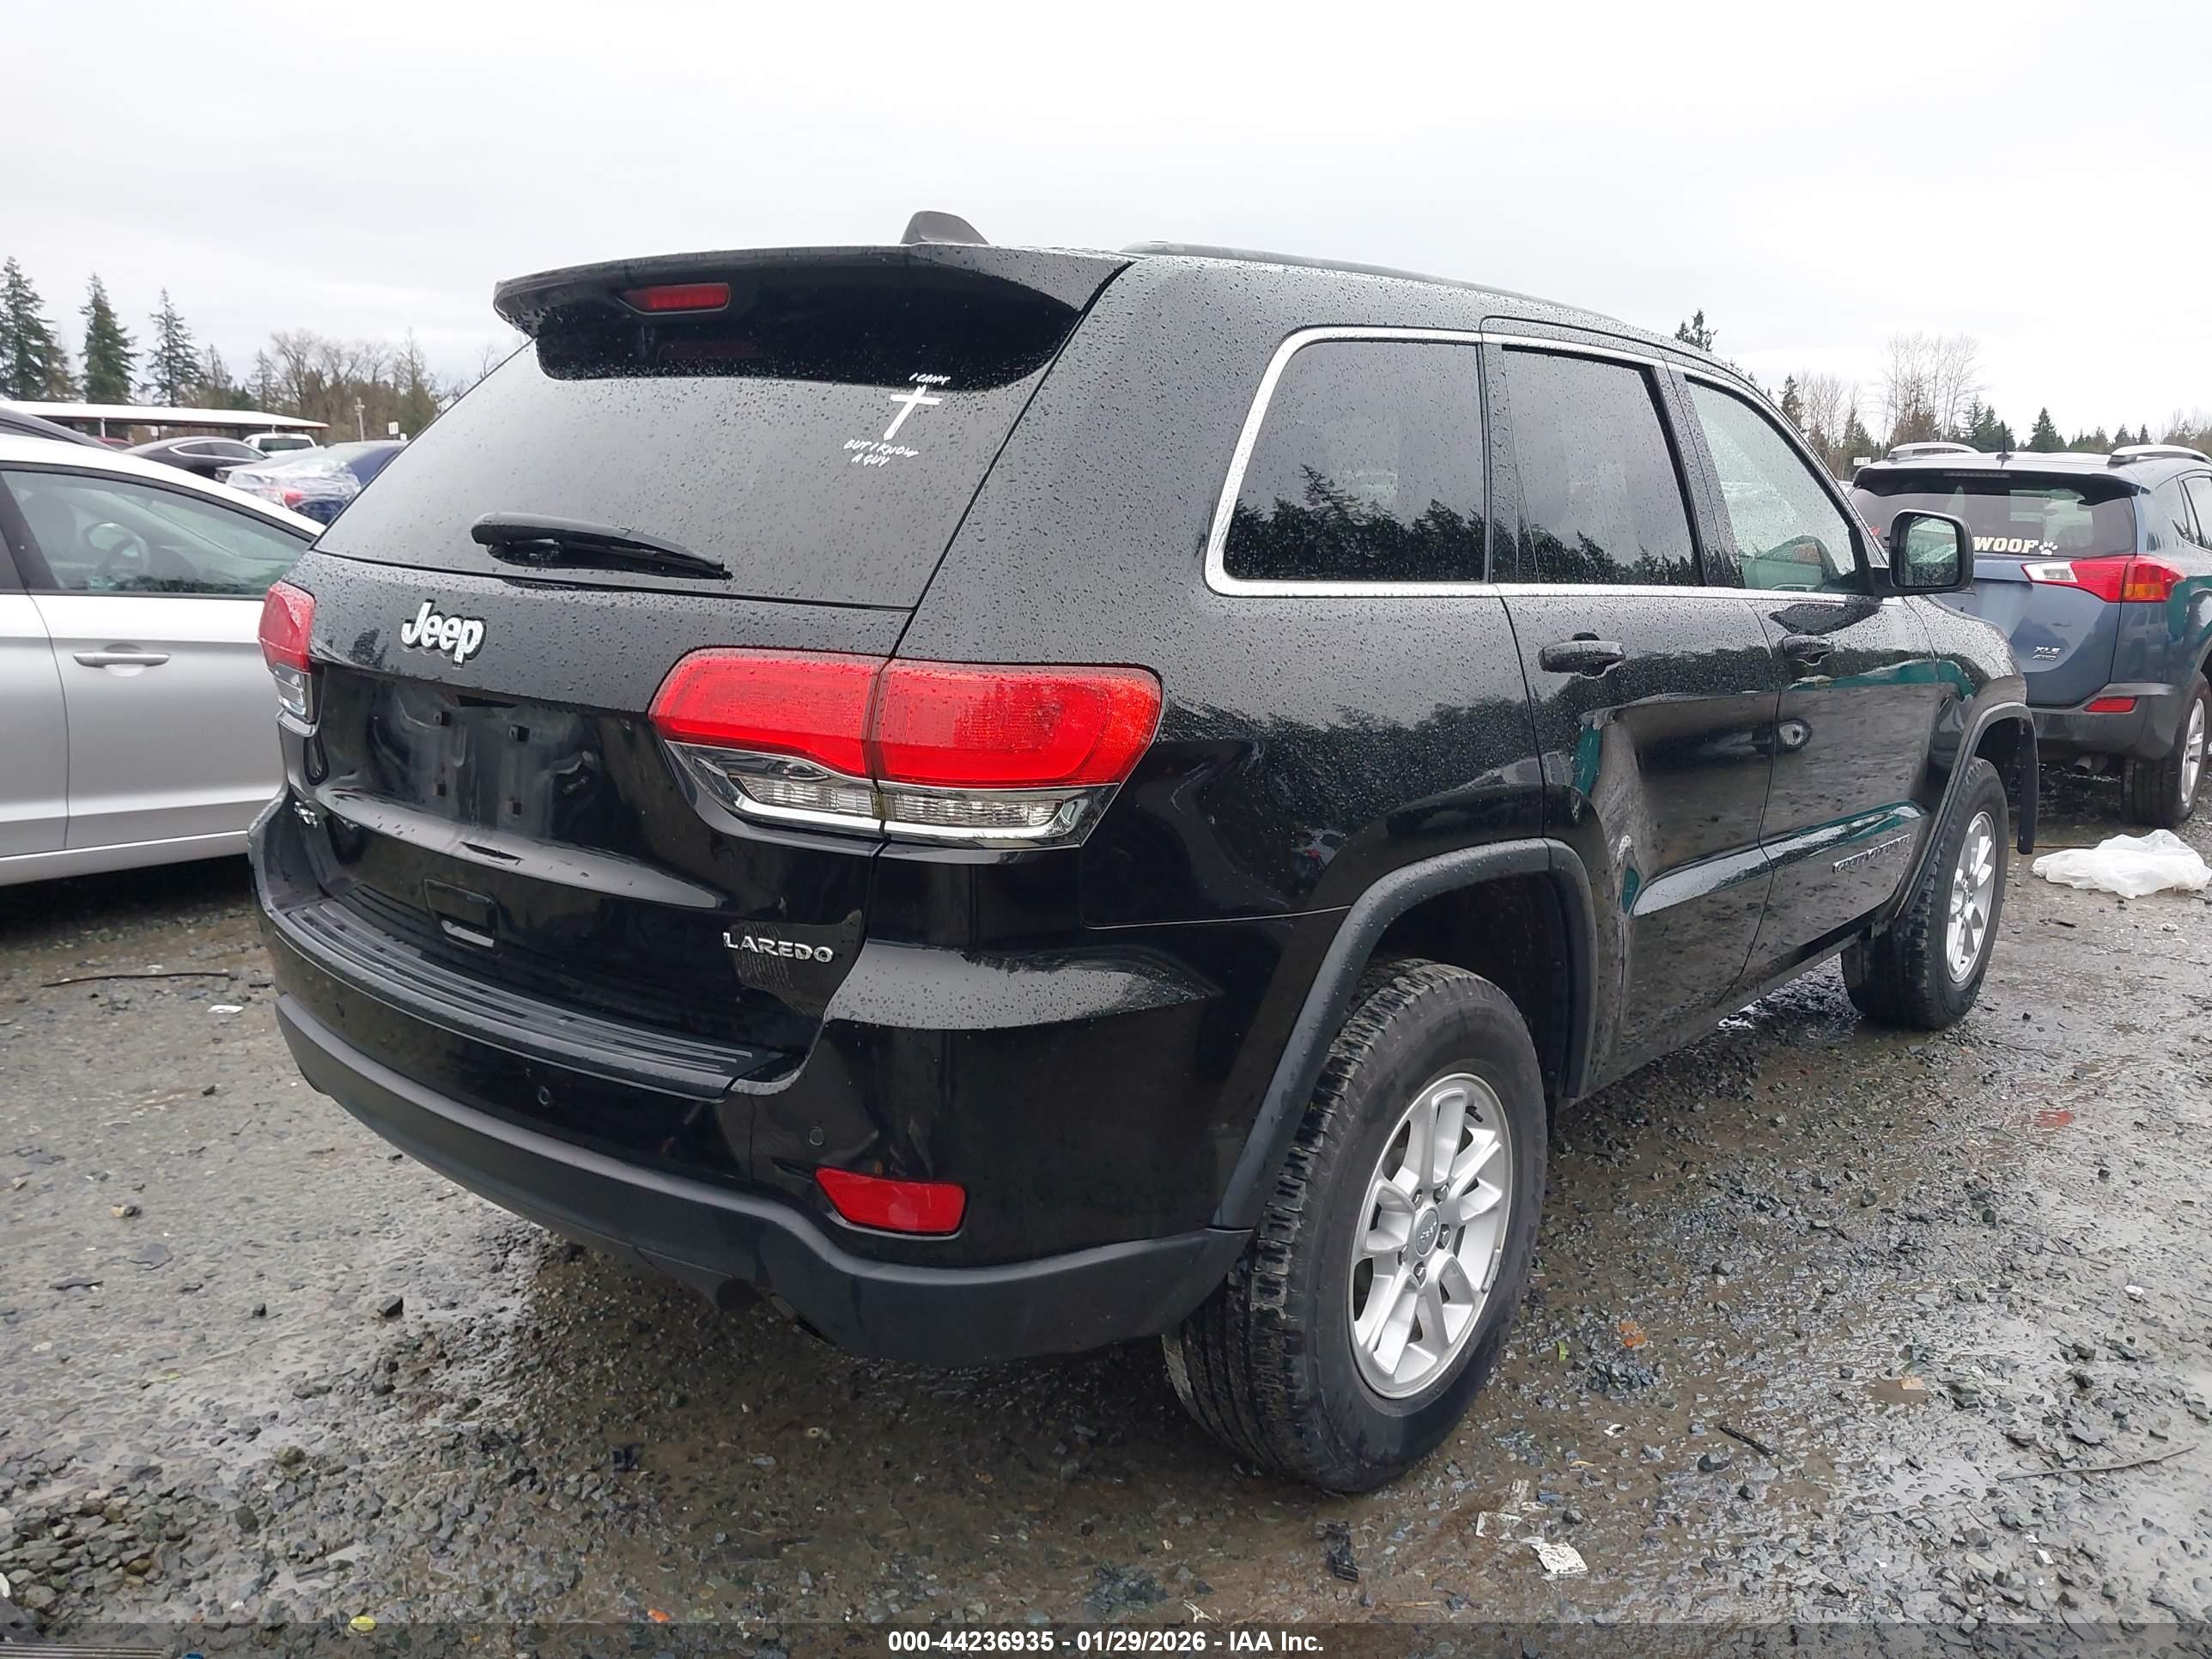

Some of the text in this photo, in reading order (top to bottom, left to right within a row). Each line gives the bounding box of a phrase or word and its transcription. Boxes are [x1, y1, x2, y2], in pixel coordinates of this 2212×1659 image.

[843, 439, 872, 450] BUT
[877, 443, 919, 458] KNOW
[851, 453, 890, 467] A GUY
[1973, 537, 2039, 554] WOOF
[400, 601, 485, 665] Jeep
[722, 932, 834, 963] LAREDO
